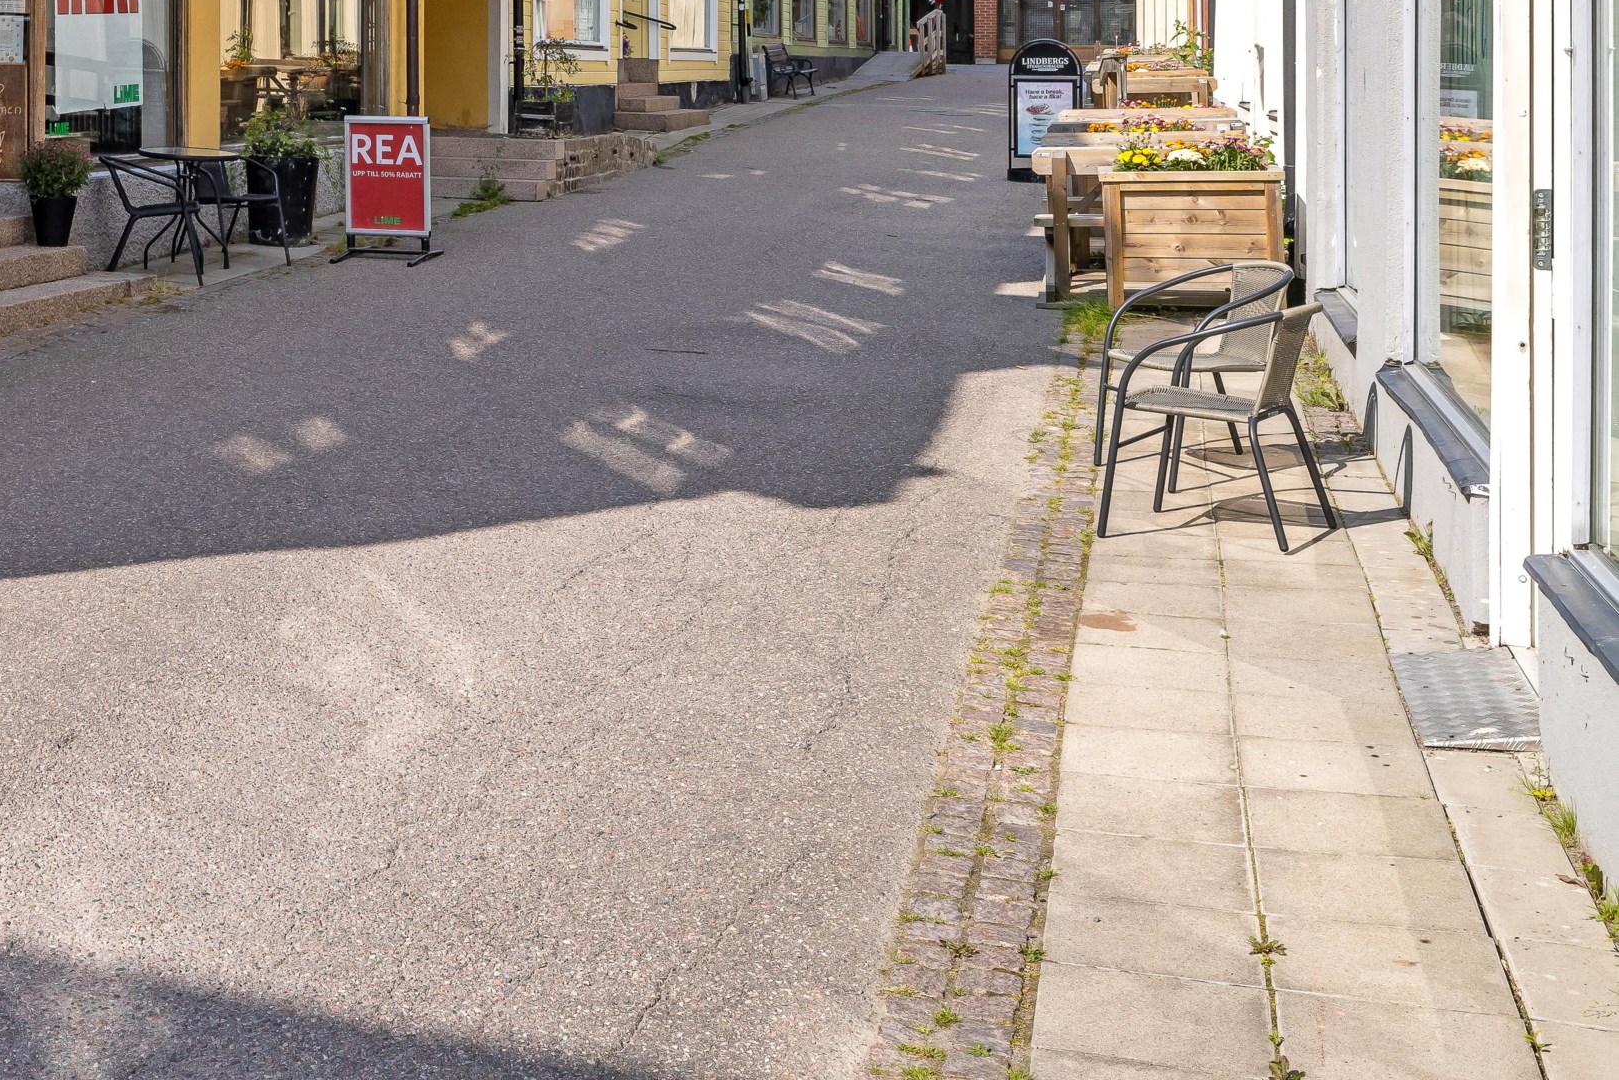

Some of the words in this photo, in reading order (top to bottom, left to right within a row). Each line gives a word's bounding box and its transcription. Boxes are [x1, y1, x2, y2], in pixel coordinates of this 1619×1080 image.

[1022, 57, 1069, 65] LINDBERGS
[351, 133, 423, 166] REA
[367, 170, 380, 178] TILL
[397, 171, 422, 179] RABATT
